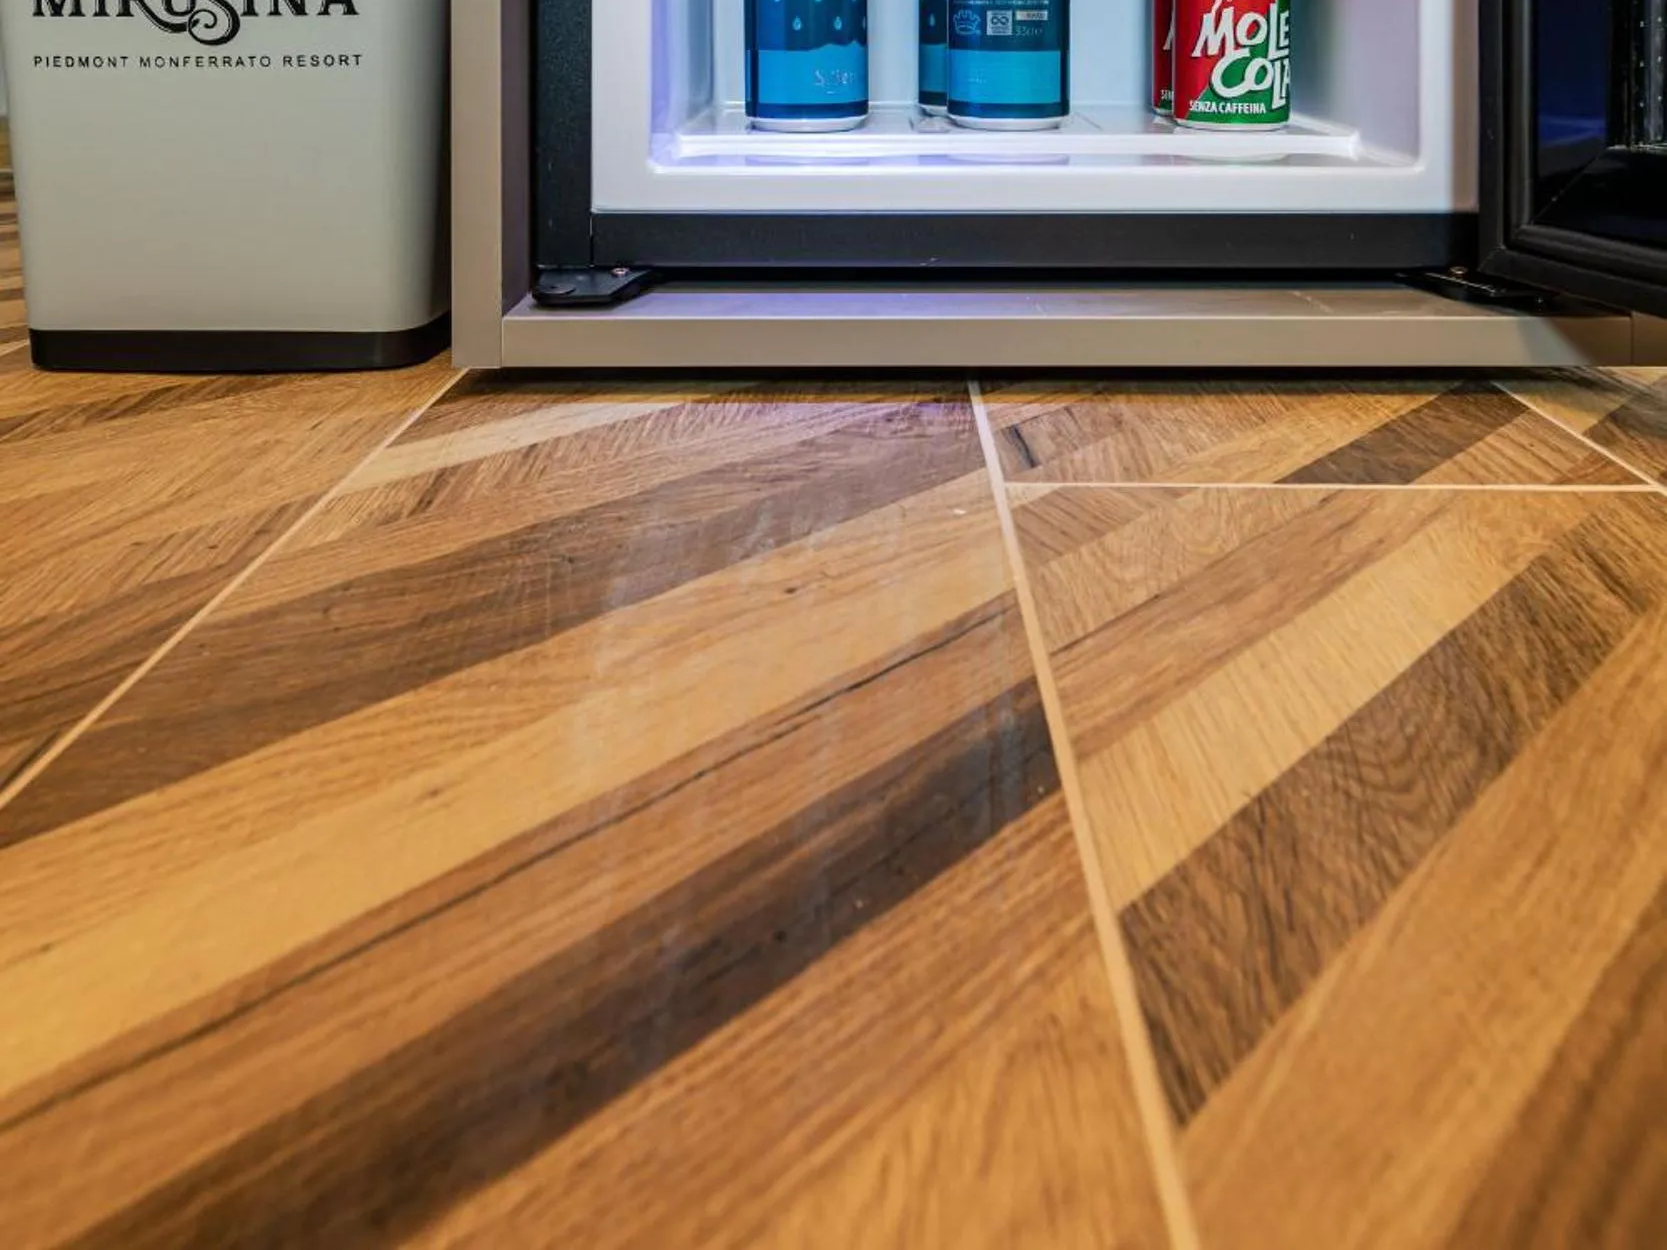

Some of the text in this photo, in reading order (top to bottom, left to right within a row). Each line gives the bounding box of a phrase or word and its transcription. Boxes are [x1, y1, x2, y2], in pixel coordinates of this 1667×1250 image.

[34, 53, 363, 68] PIEDMONT MONFERRATO RESORT
[1189, 100, 1266, 114] SENZA CAFFEINA
